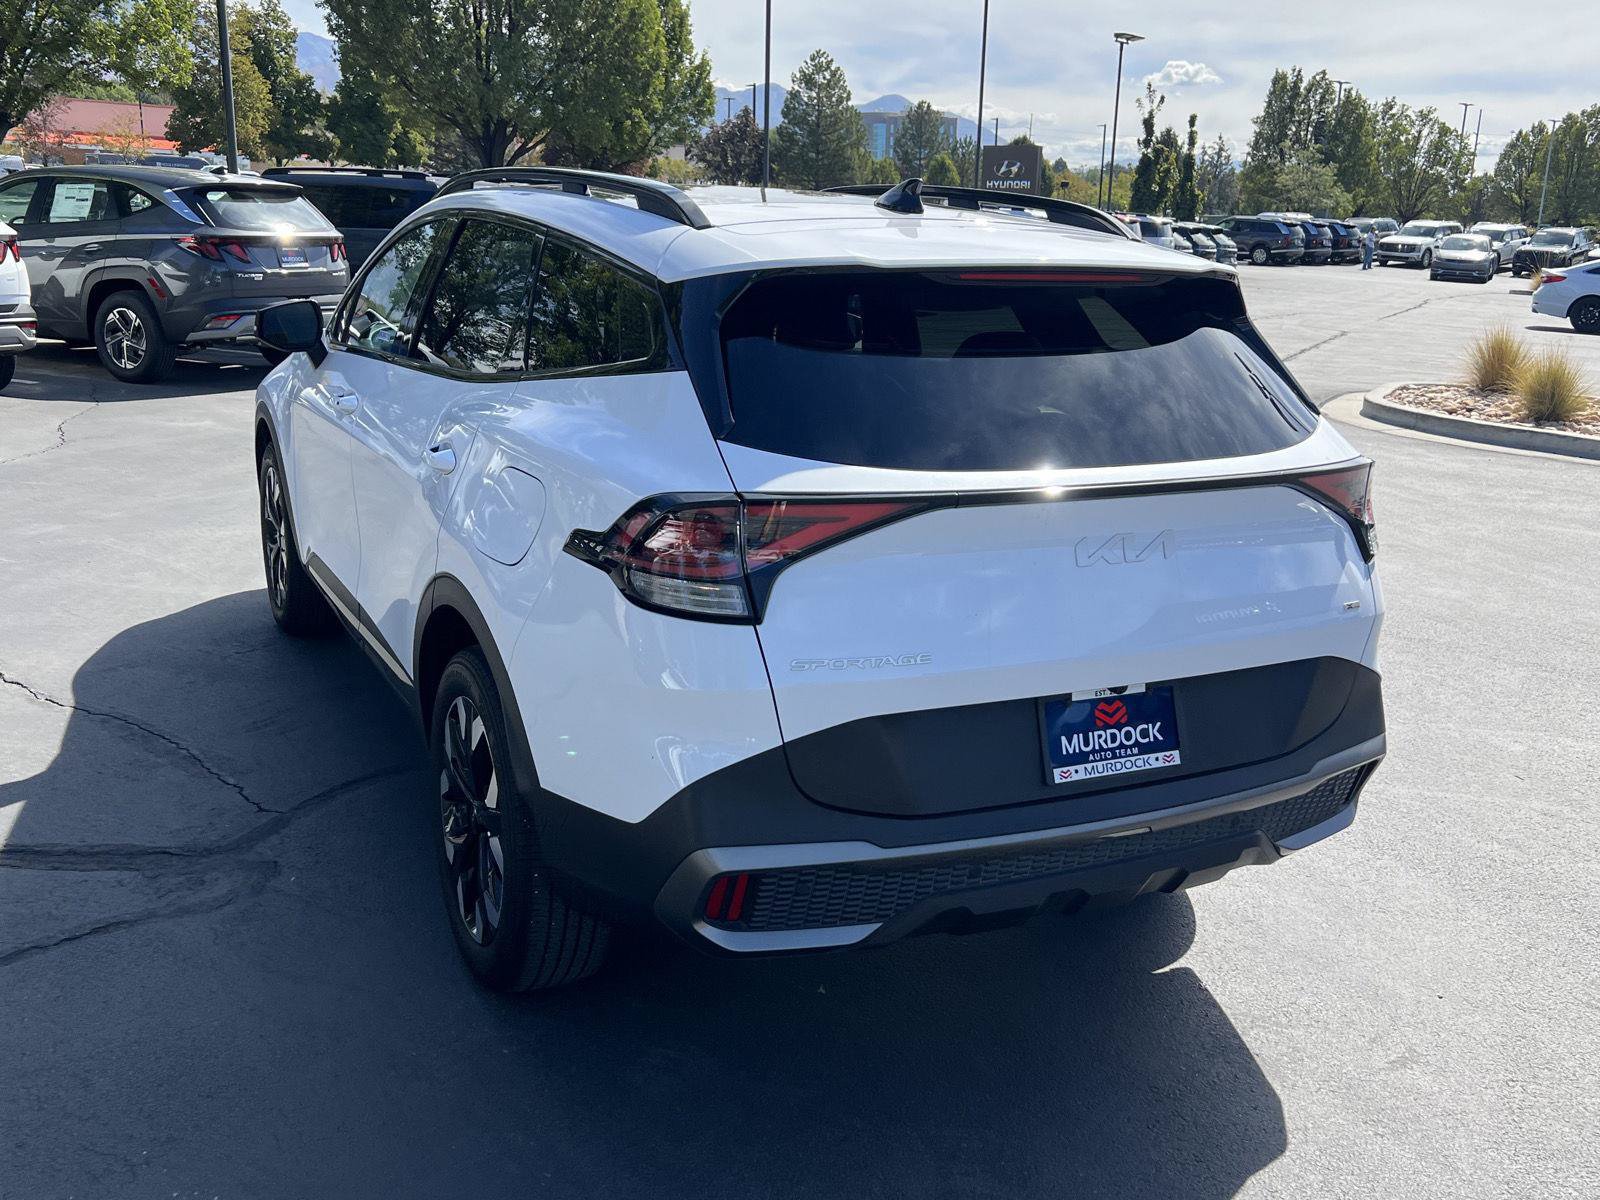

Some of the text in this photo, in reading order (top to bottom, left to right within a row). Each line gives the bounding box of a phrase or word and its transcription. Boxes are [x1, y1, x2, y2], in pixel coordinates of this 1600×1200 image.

[986, 180, 1031, 189] HYUNDAI
[1074, 529, 1171, 567] KIA
[789, 652, 933, 672] SPORTAGE
[1061, 722, 1163, 755] MURDOCK
[1088, 747, 1139, 762] AUTO TEAM
[1084, 756, 1153, 777] MURDOCK
